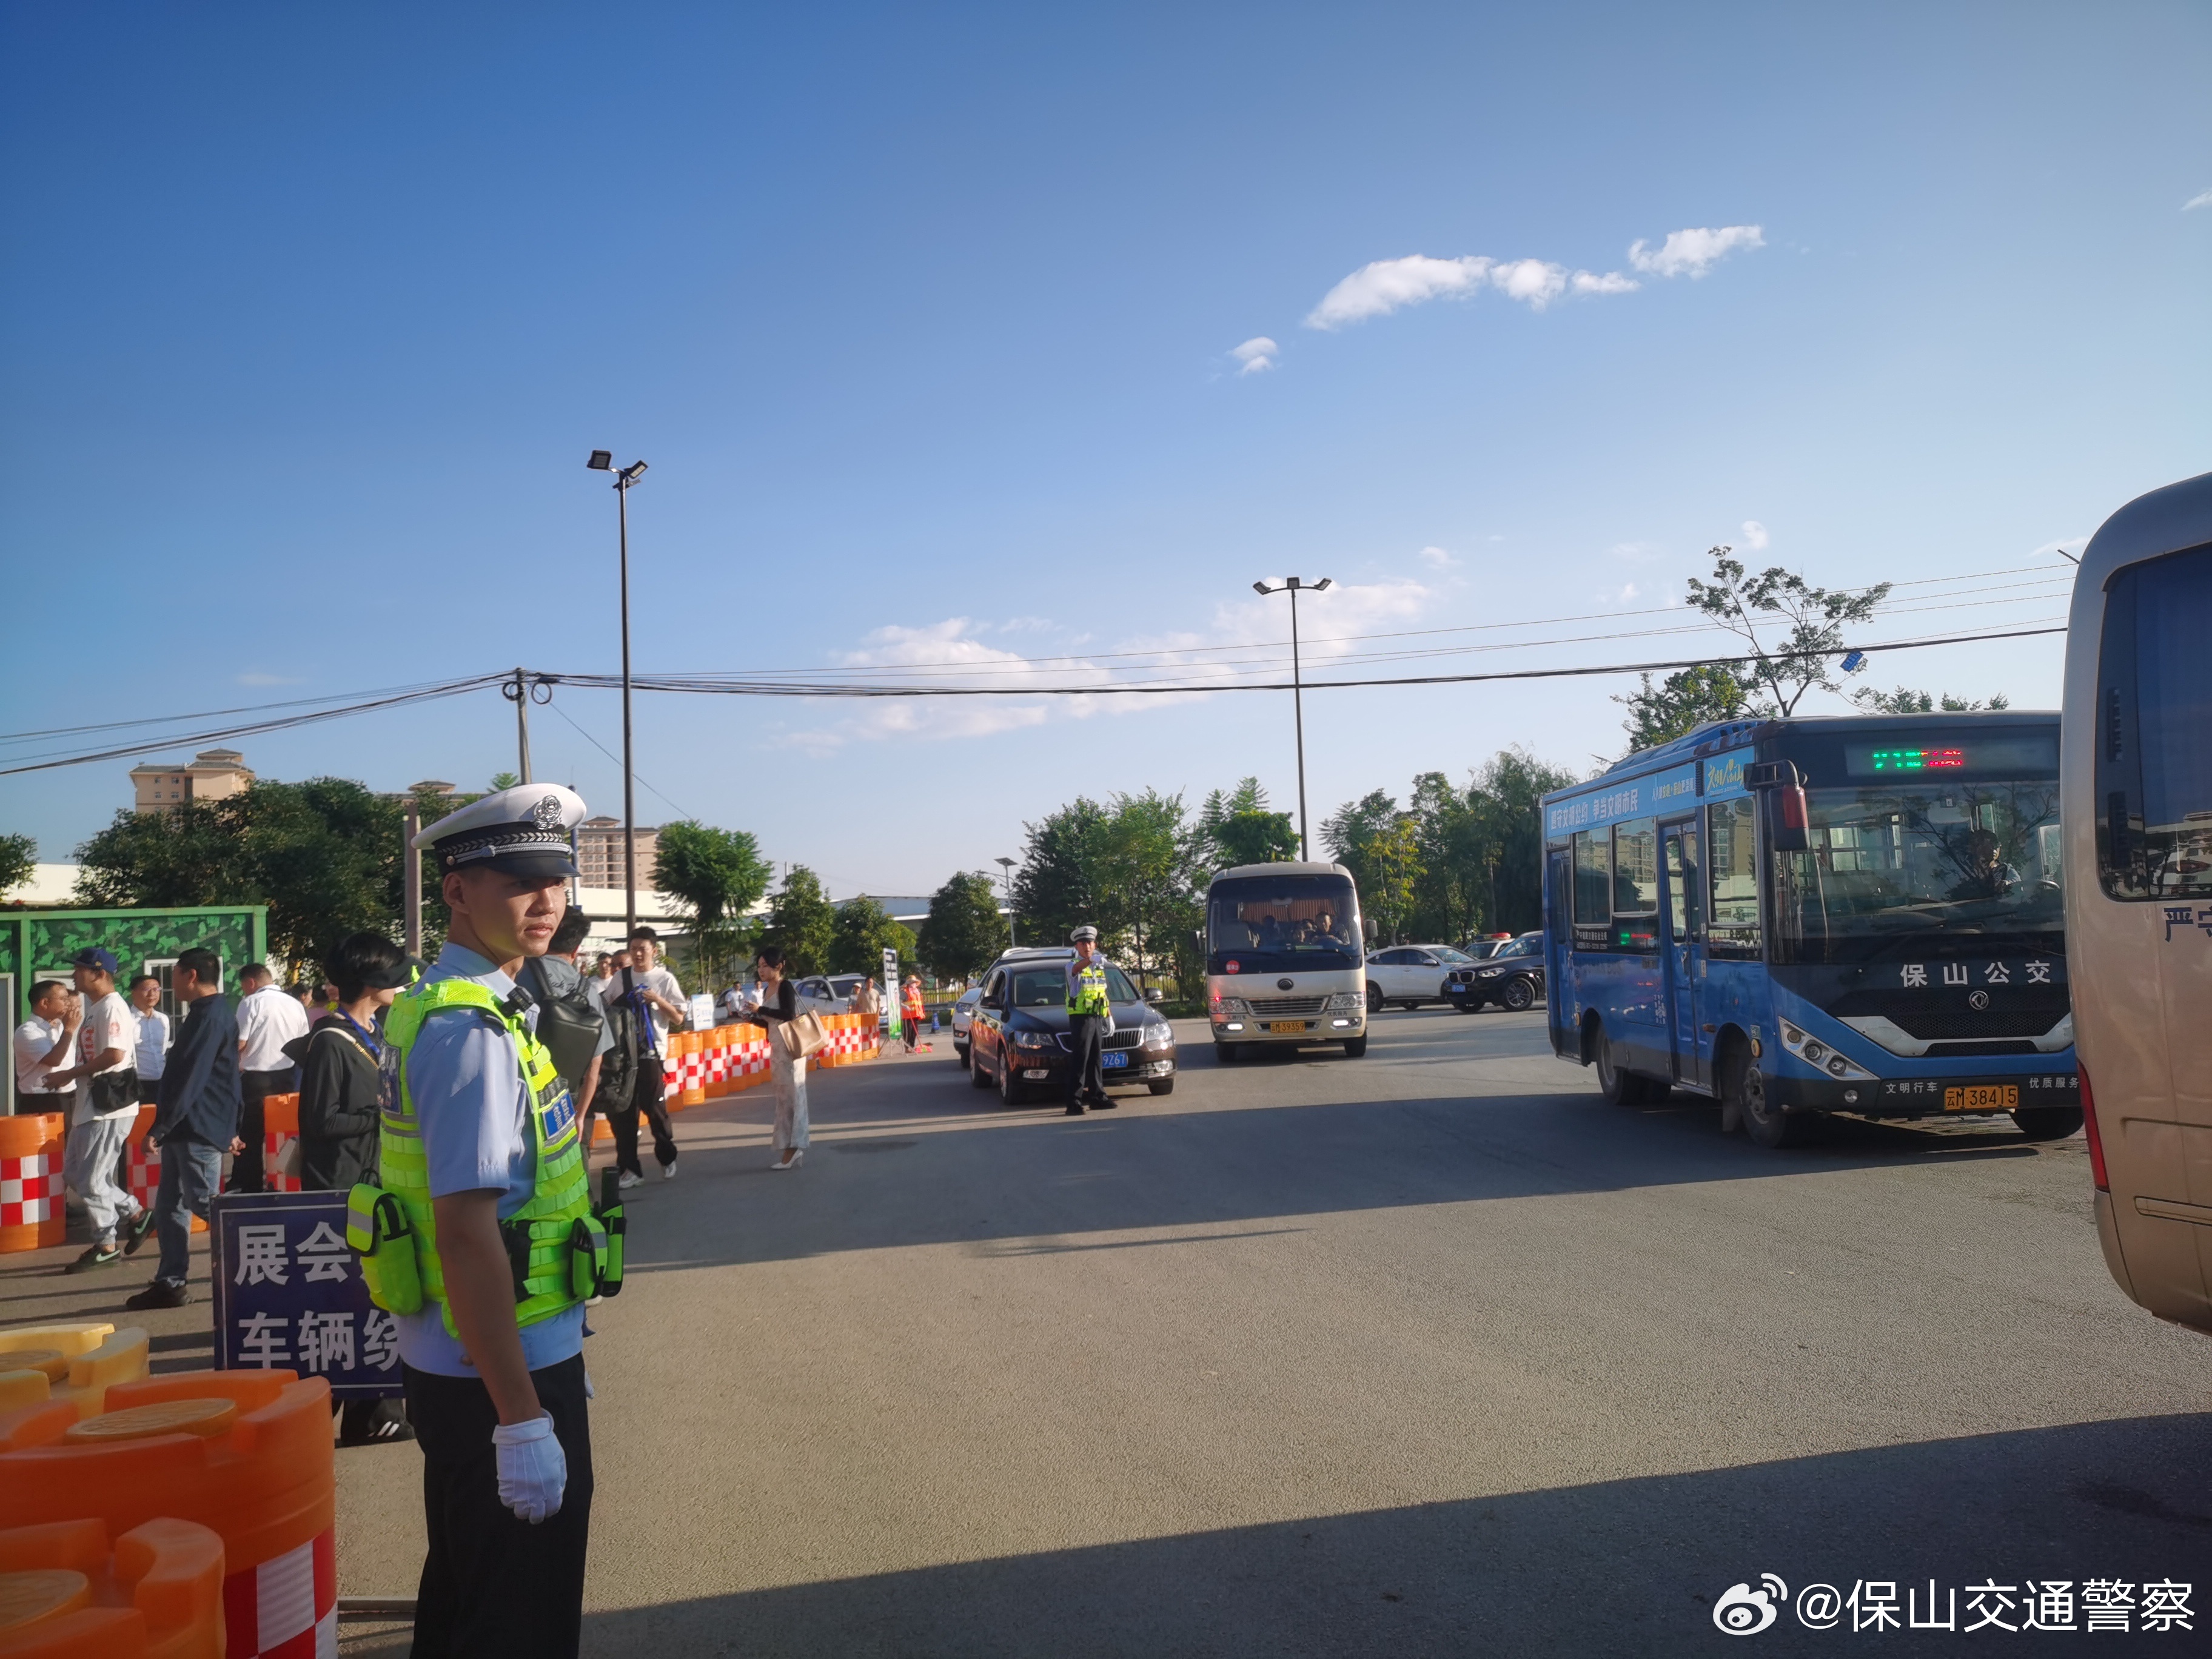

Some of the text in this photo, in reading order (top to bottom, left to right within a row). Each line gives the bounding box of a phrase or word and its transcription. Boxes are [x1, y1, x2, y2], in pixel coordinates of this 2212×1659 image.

[1593, 788, 1638, 820] 争当文明市民
[1900, 960, 2051, 987] 保山公交
[1886, 1082, 1938, 1094] 文明行车
[2029, 1077, 2079, 1089] 优质服务
[234, 1221, 372, 1285] 展会
